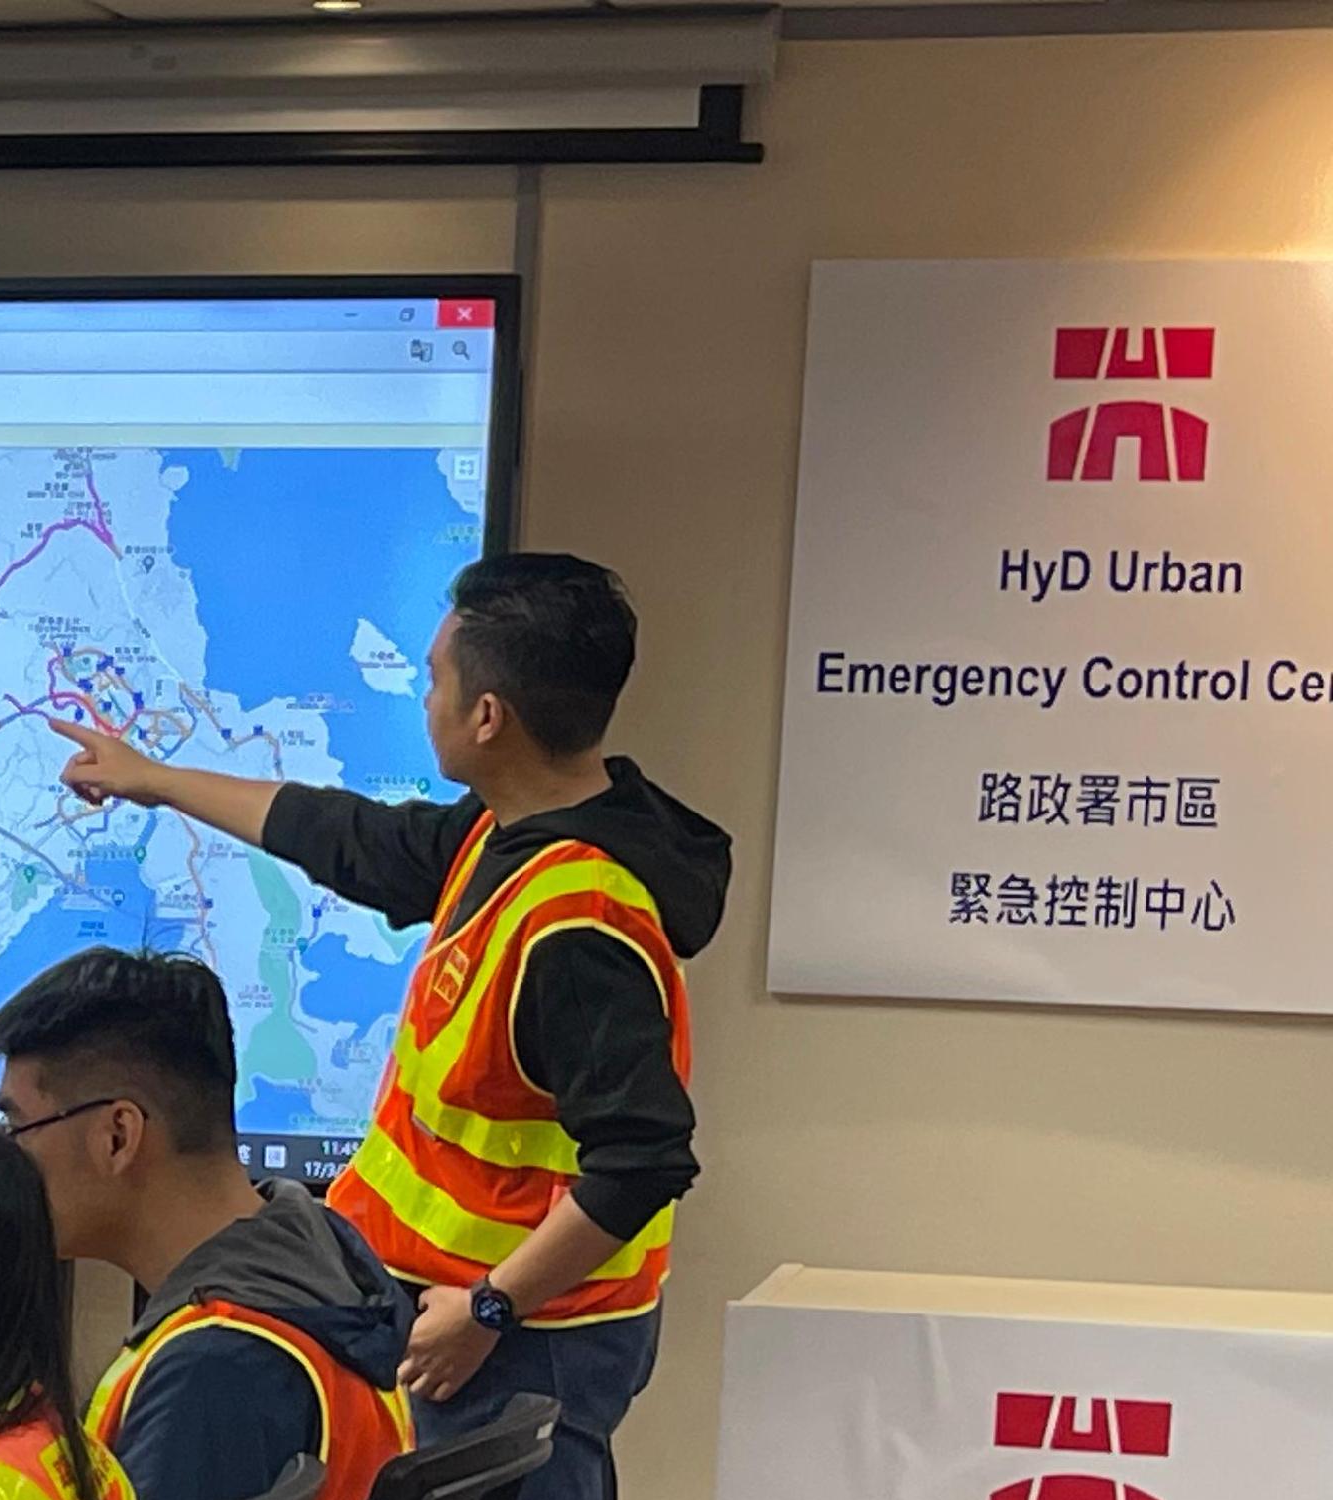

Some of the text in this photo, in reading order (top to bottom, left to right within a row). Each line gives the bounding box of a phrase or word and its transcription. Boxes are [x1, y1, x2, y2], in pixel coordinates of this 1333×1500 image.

[1000, 549, 1243, 602] HyD Urban
[816, 652, 1067, 708] Emergency
[1082, 657, 1250, 703] Control
[978, 772, 1221, 828] 路政署市區
[949, 872, 1237, 932] 緊急控制中心
